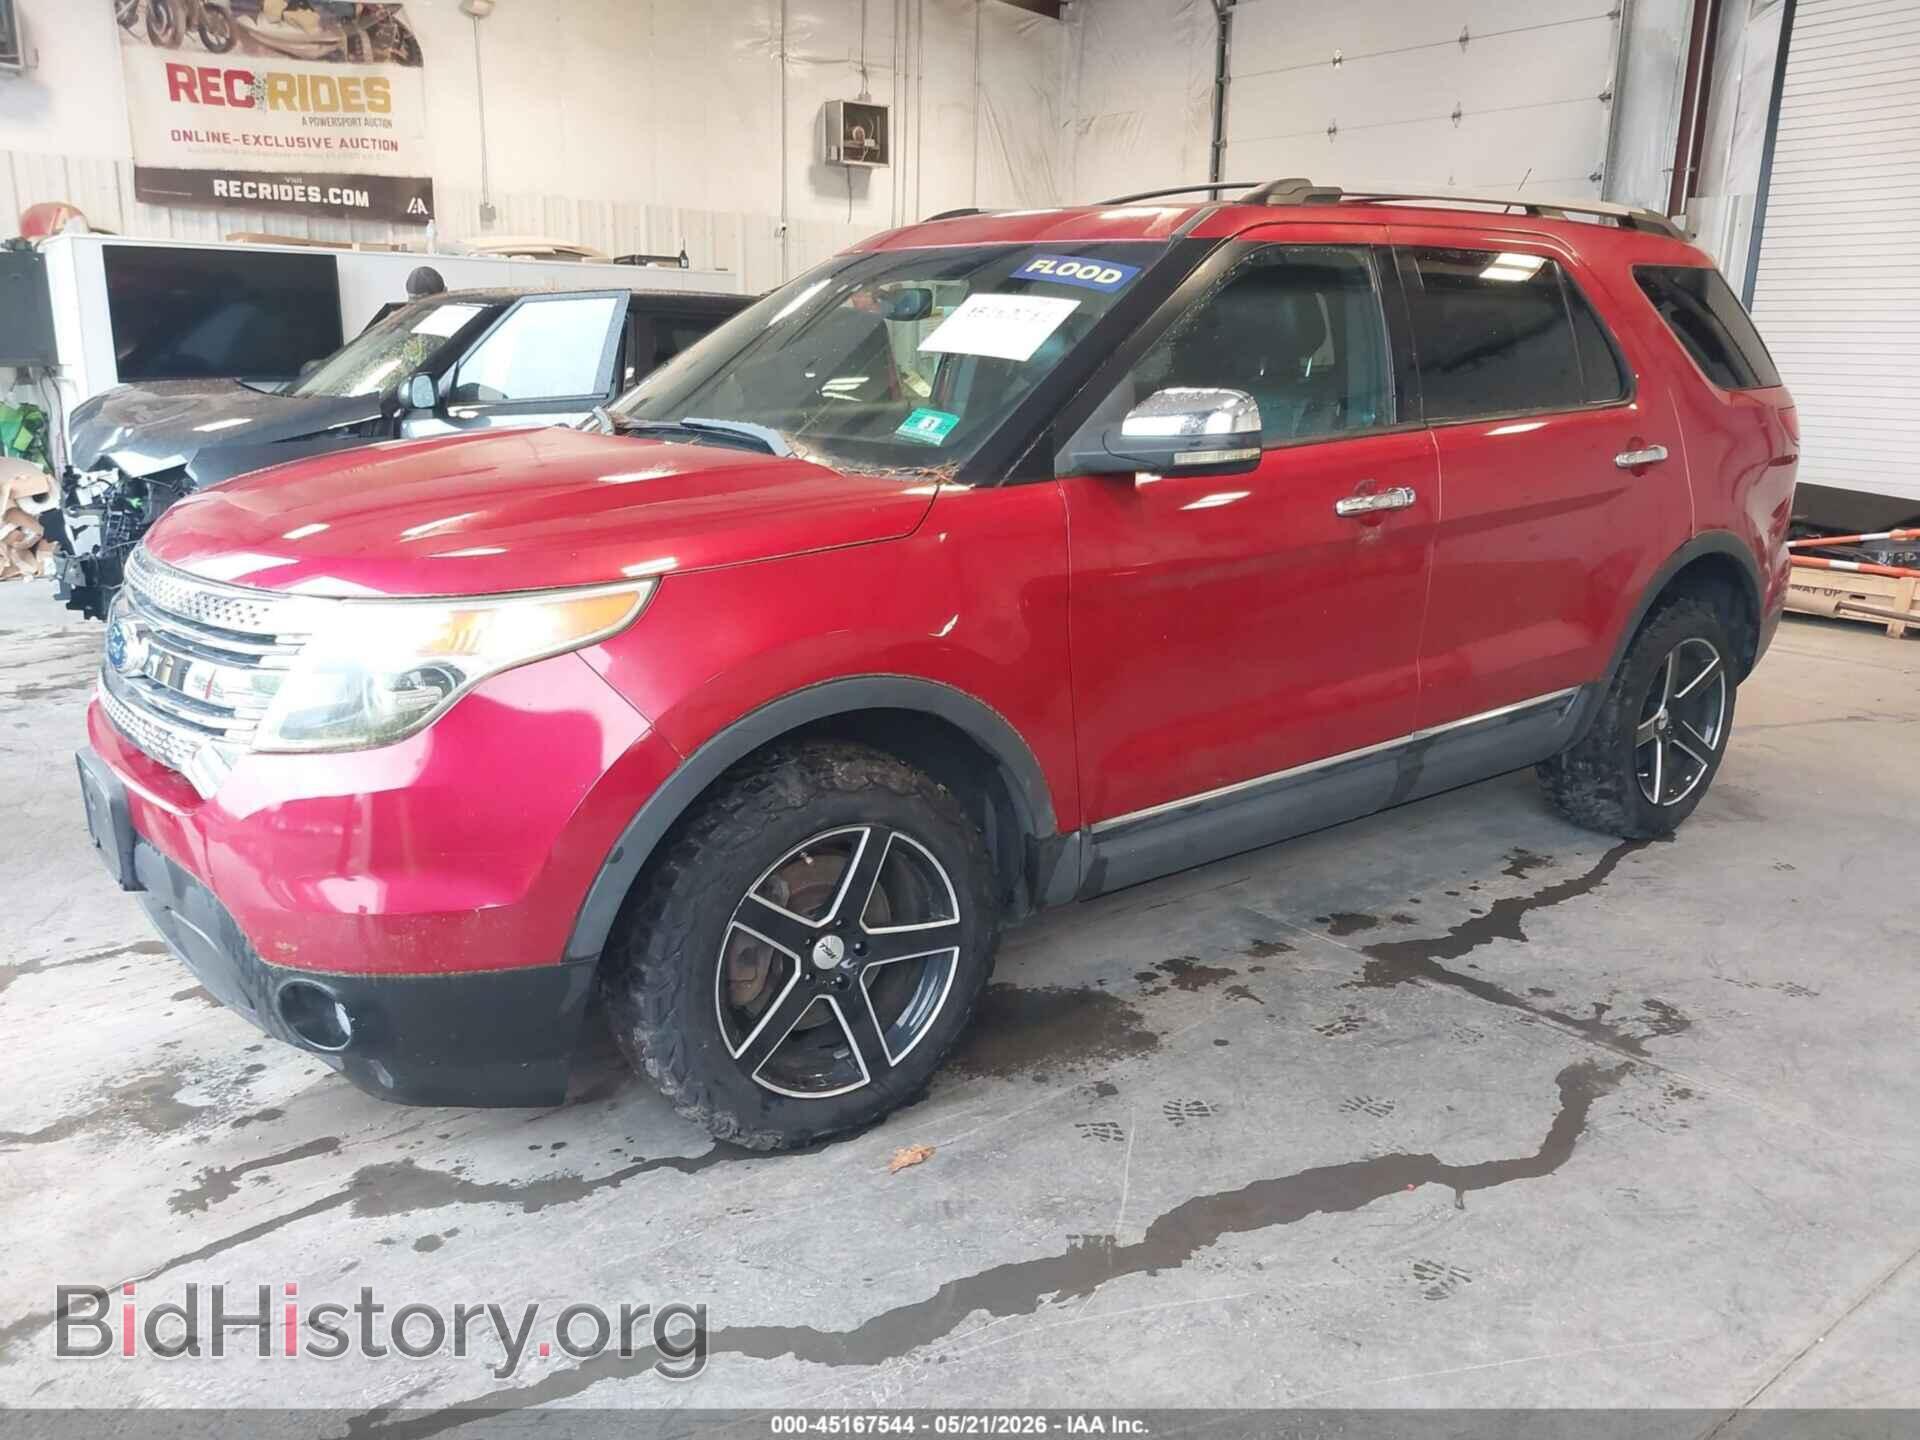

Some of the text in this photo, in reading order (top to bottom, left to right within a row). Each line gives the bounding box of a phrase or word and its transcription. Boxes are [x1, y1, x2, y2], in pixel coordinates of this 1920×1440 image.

[165, 62, 392, 113] REC RIDES
[309, 117, 362, 128] POWERSPORT
[364, 118, 393, 129] AUCTION
[170, 129, 399, 153] ONLINE-EXCLUSIVE AUCTION
[213, 179, 370, 208] RECRIDES.COM
[1025, 260, 1124, 284] FLOOD
